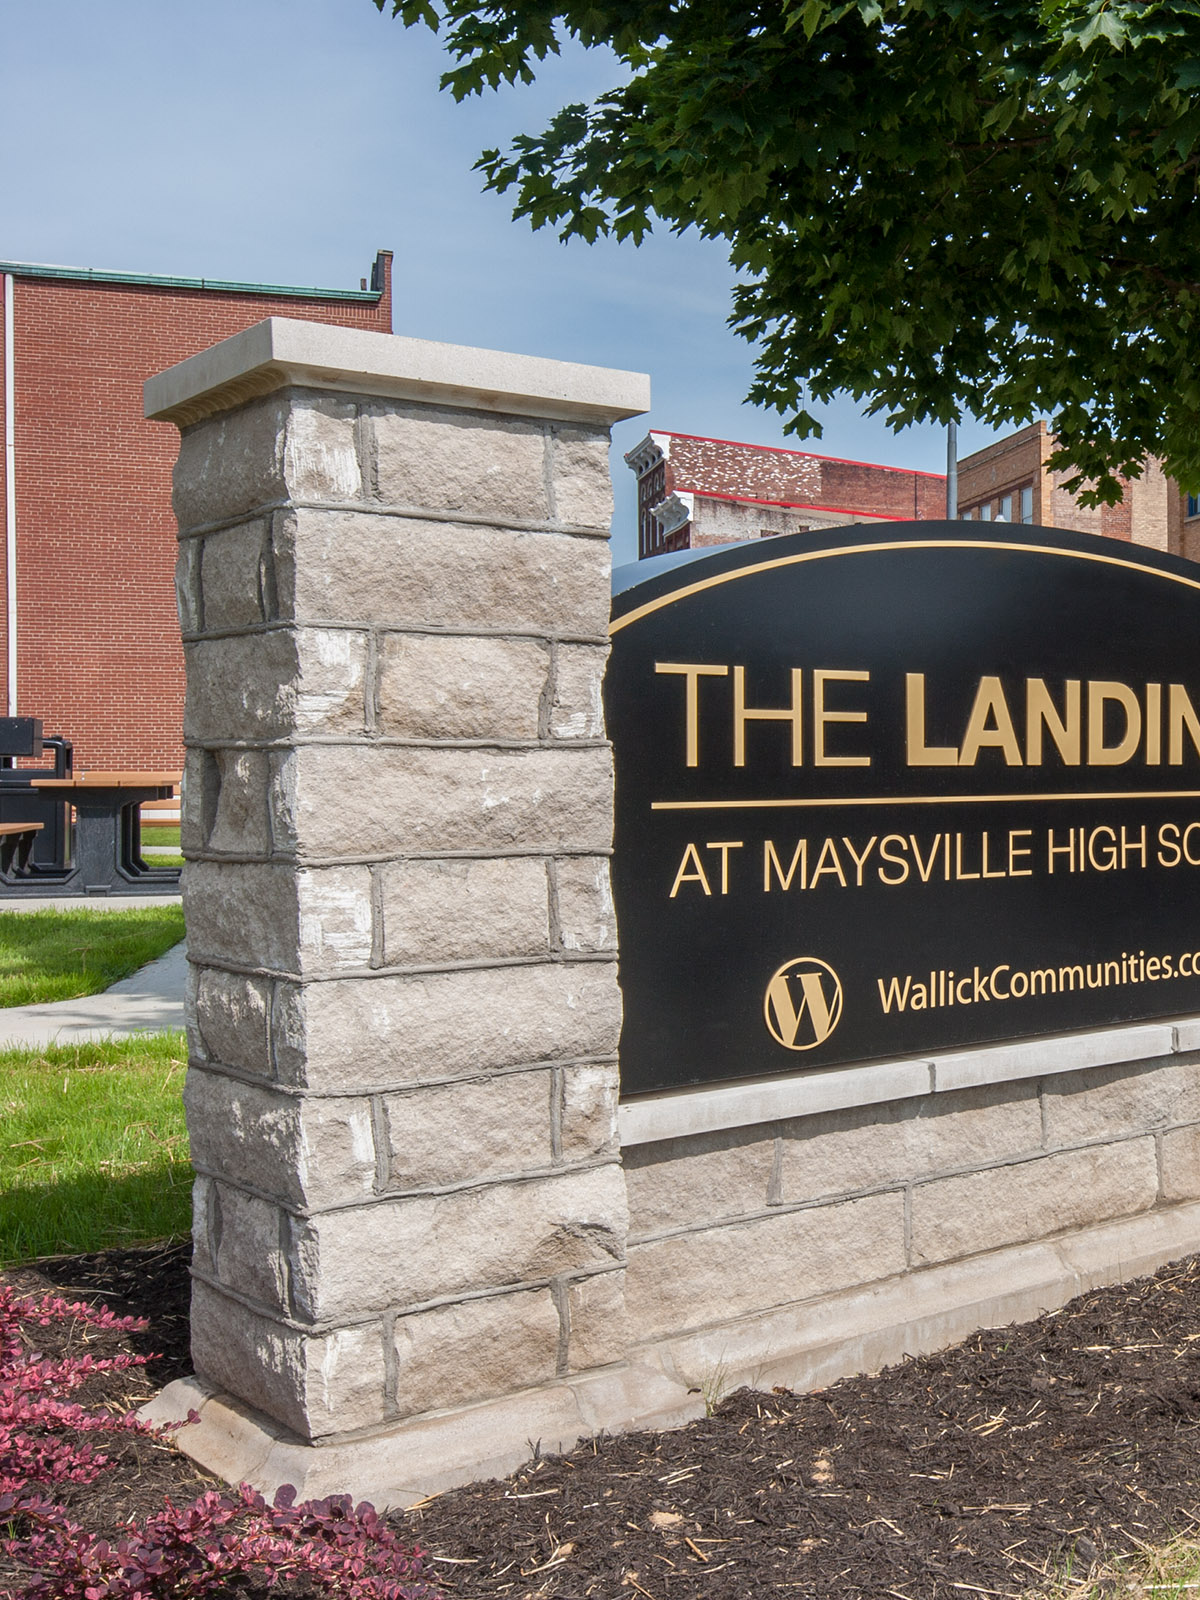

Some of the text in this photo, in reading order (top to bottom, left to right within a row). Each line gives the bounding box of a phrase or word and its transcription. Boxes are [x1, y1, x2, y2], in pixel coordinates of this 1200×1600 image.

[655, 662, 871, 768] THE
[668, 840, 744, 899] AT
[763, 829, 1033, 893] MAYSVILLE
[1047, 824, 1147, 874] HIGH
[770, 972, 838, 1048] W
